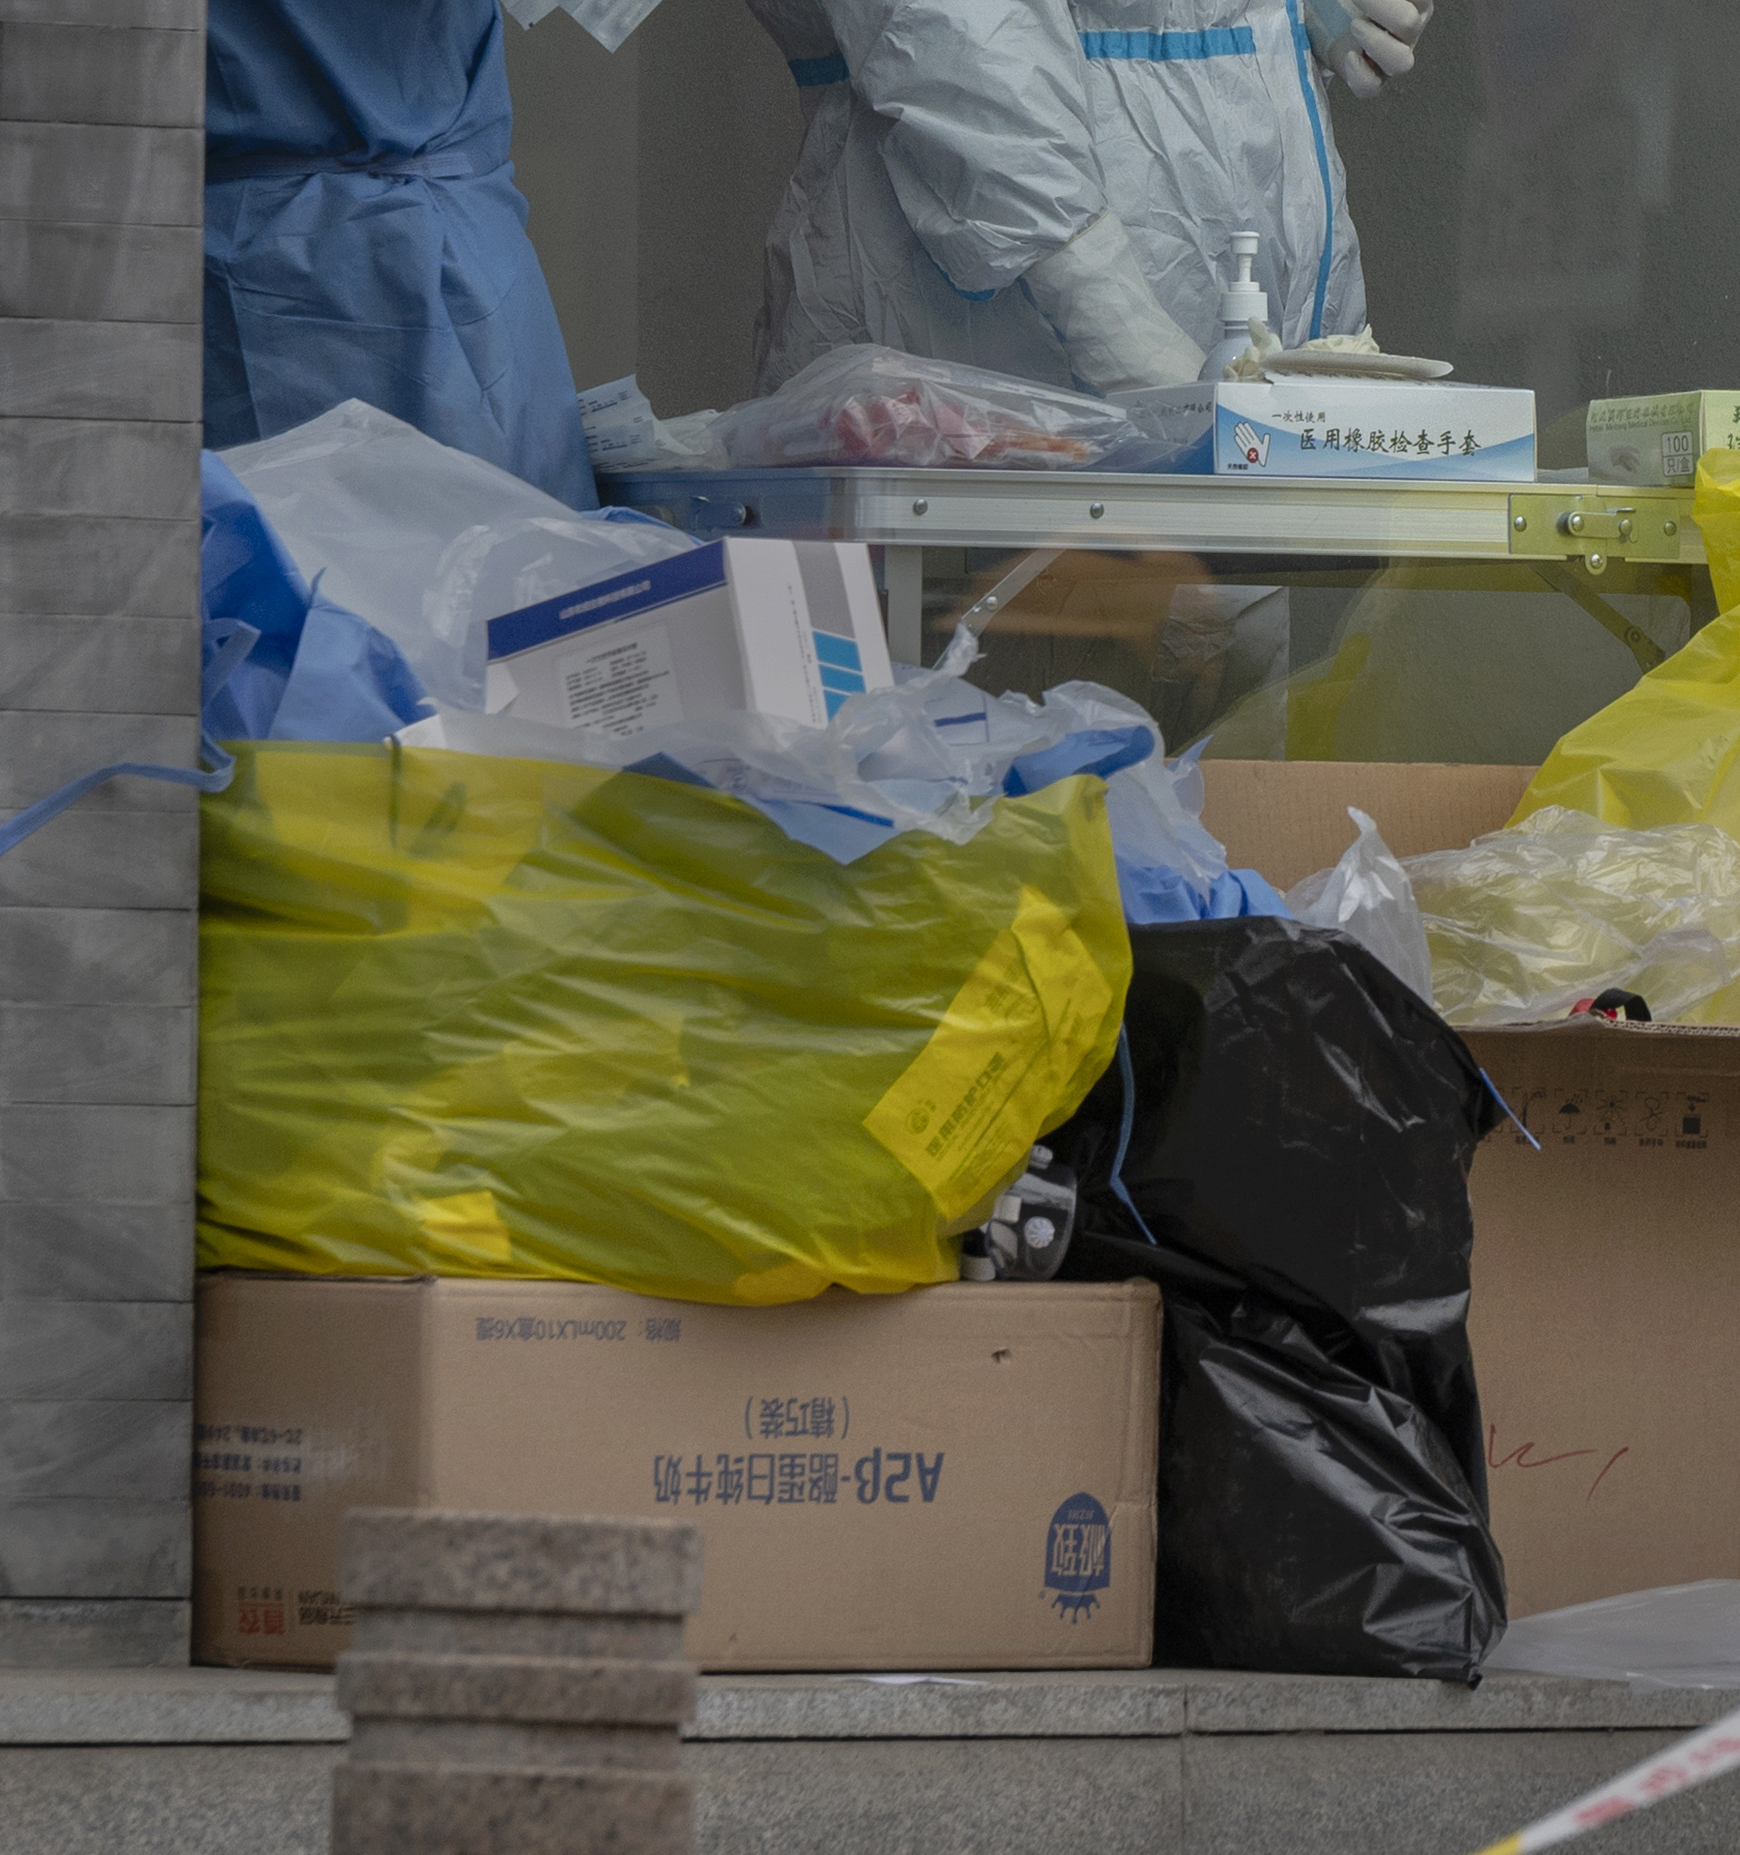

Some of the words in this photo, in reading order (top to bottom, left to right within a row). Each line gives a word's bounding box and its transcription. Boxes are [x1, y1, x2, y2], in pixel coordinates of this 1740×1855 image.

[1299, 427, 1481, 457] 医用橡胶检查手套
[1666, 434, 1690, 453] 100
[1666, 456, 1690, 474] 只/盒
